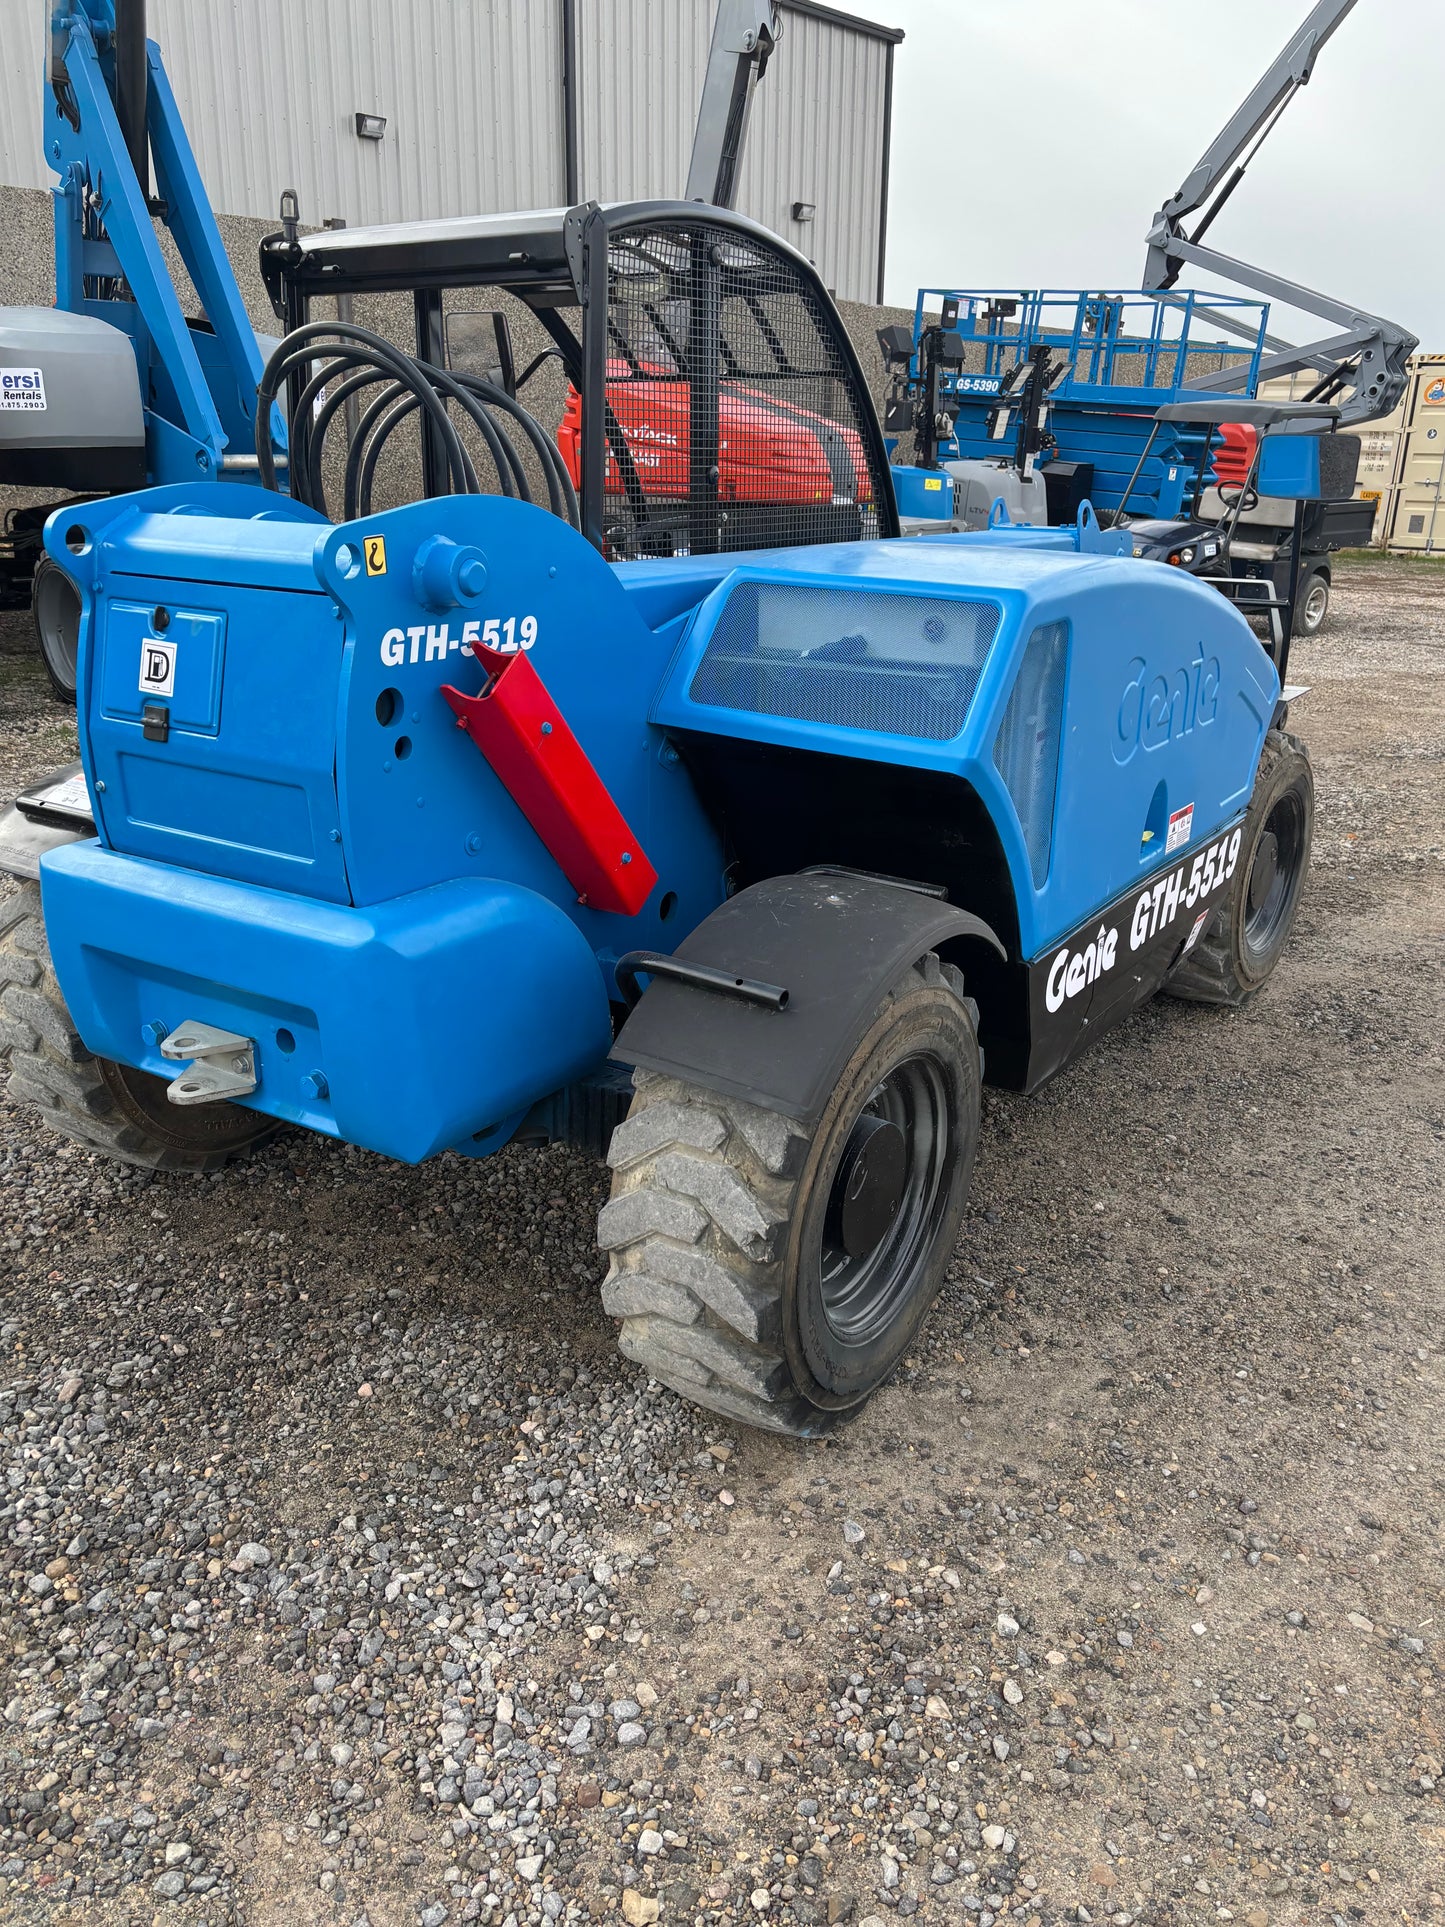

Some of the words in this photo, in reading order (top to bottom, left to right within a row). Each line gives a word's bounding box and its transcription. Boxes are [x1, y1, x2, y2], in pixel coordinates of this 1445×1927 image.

[0, 371, 41, 388] ersi
[3, 391, 42, 400] Rentals
[956, 378, 999, 392] GS-5390
[380, 615, 538, 667] GTH-5519
[144, 648, 170, 684] D
[1110, 640, 1220, 766] Genie
[1045, 923, 1119, 1013] Genie
[1129, 828, 1242, 951] GTH-5519
